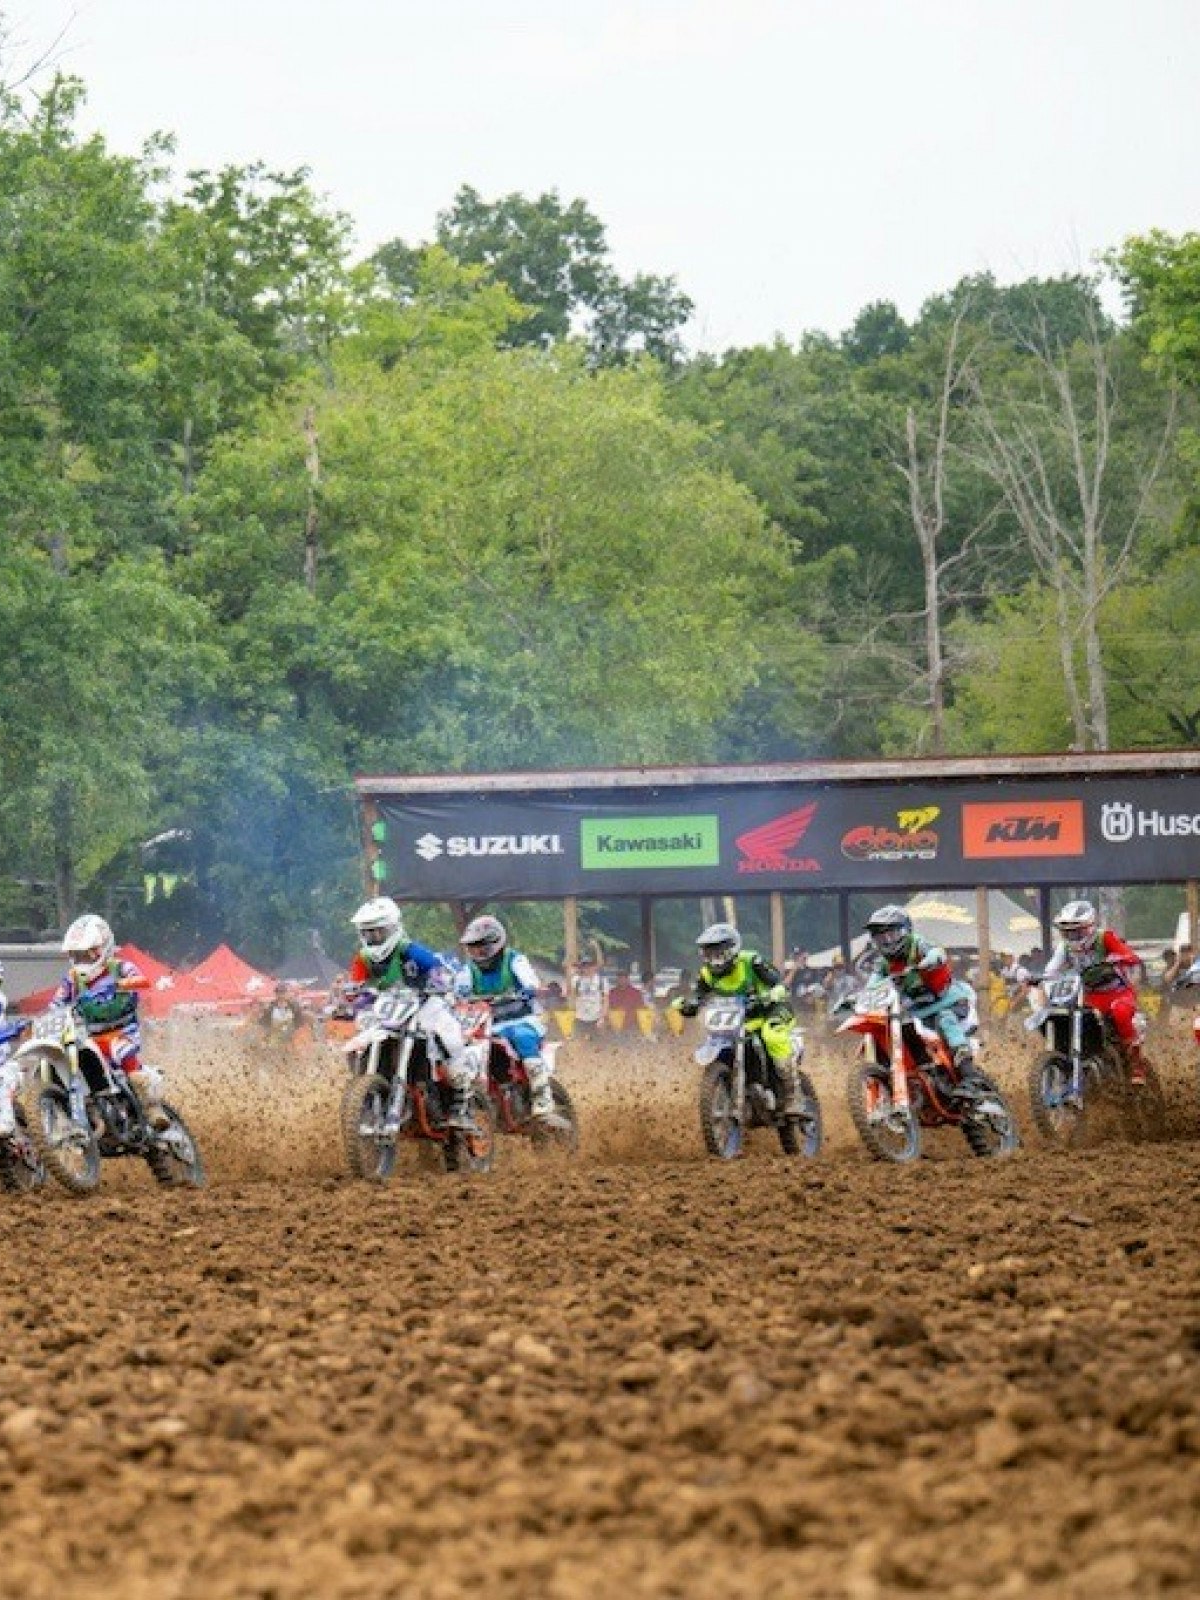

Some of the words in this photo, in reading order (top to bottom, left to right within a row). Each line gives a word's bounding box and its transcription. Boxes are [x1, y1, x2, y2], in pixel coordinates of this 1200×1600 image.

[984, 815, 1060, 843] KTM
[446, 833, 559, 857] SUZUKI
[596, 832, 704, 854] Kawasaki
[736, 859, 822, 873] HONDA
[707, 1010, 738, 1028] 47
